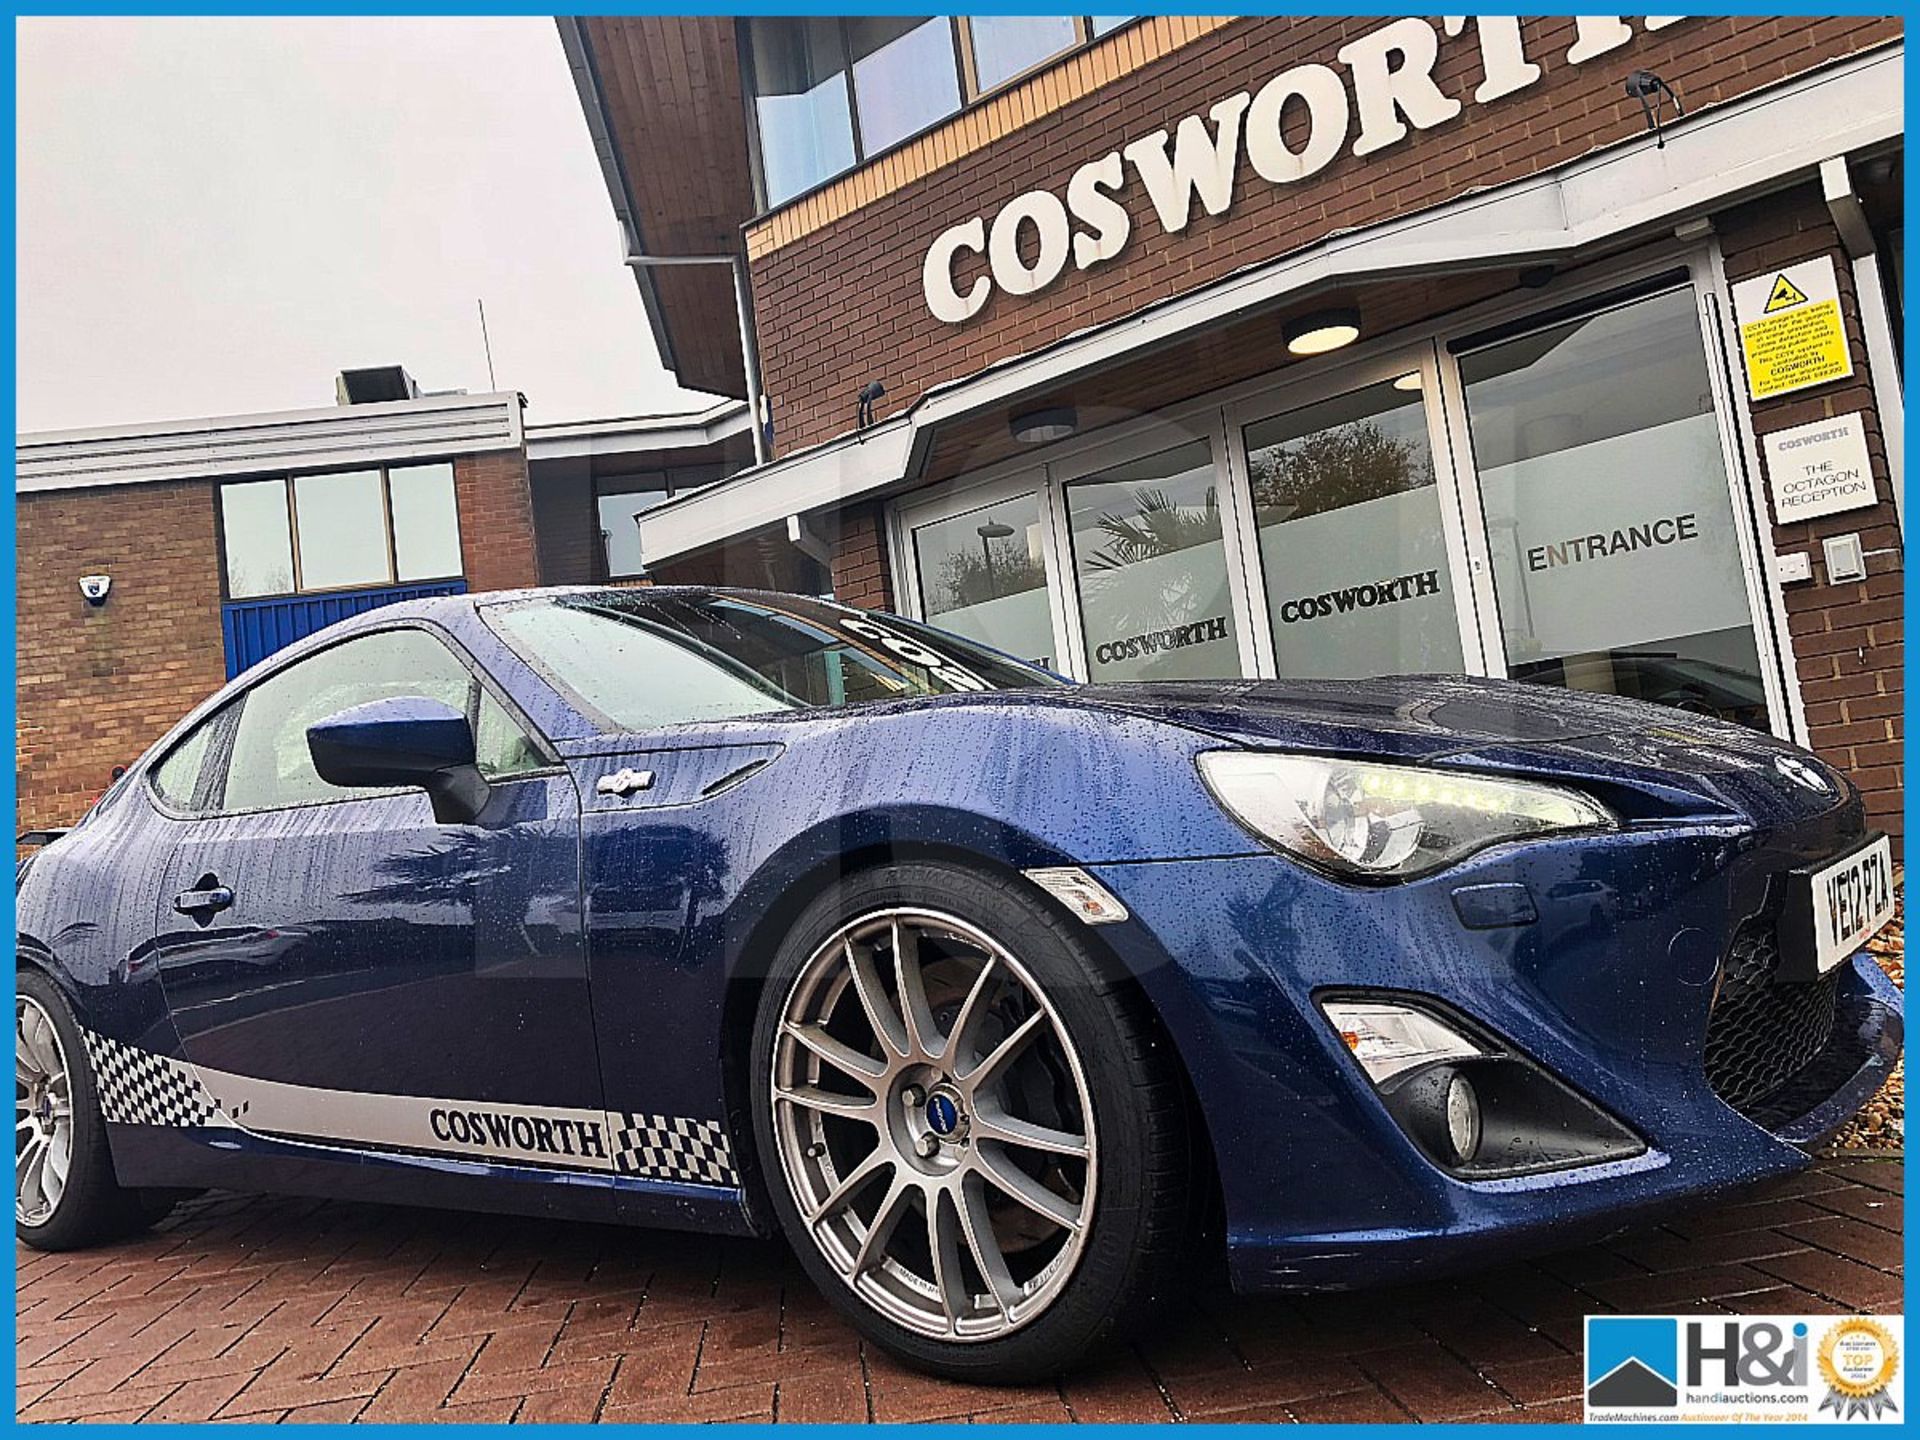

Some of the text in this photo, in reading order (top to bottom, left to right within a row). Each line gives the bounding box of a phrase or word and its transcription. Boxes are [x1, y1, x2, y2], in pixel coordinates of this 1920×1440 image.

[1770, 355, 1824, 375] COSWORTH
[1778, 427, 1849, 451] COSWORTH
[1783, 468, 1859, 494] OCTAGON
[1803, 461, 1833, 475] THE
[1781, 481, 1867, 507] RECEPTION
[1527, 513, 1699, 571] ENTRANCE
[1281, 570, 1441, 623] COSWORTH
[1096, 617, 1228, 665] COSWORTH
[429, 1109, 609, 1159] COSWORTH
